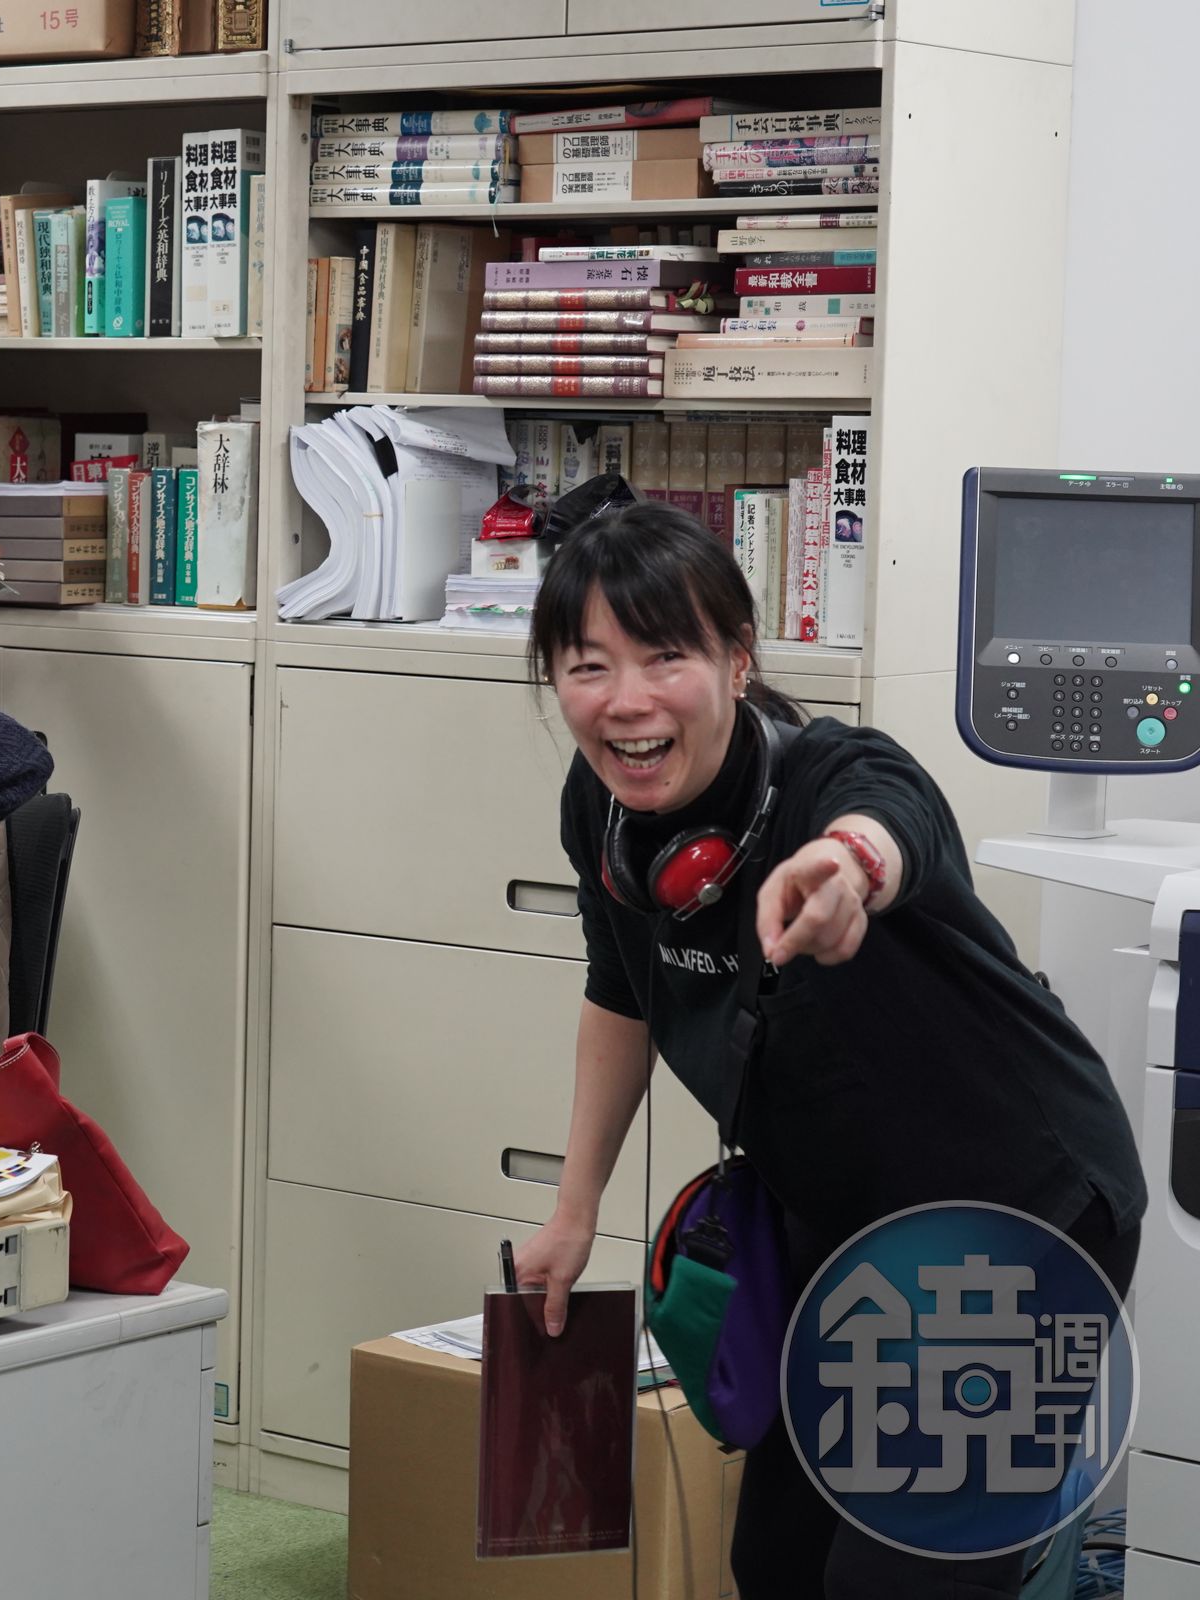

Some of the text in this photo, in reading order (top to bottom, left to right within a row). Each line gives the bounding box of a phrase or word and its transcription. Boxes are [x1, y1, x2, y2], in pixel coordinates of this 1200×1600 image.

[41, 9, 79, 30] 15号
[736, 113, 840, 133] 手芸百科事典
[211, 141, 237, 165] 料理
[563, 135, 609, 147] プロ調理師
[211, 166, 237, 191] 食材
[210, 193, 237, 211] 大事典
[156, 170, 169, 283] リーダーズ英和辞典
[748, 271, 818, 289] 最新和裁全書
[836, 429, 868, 457] 料理
[213, 434, 230, 494] 大辞林
[835, 458, 867, 486] 食材
[833, 488, 867, 507] 大事典
[155, 475, 166, 560] コンサイス地名辞典
[747, 503, 757, 574] 記者ハンドブック
